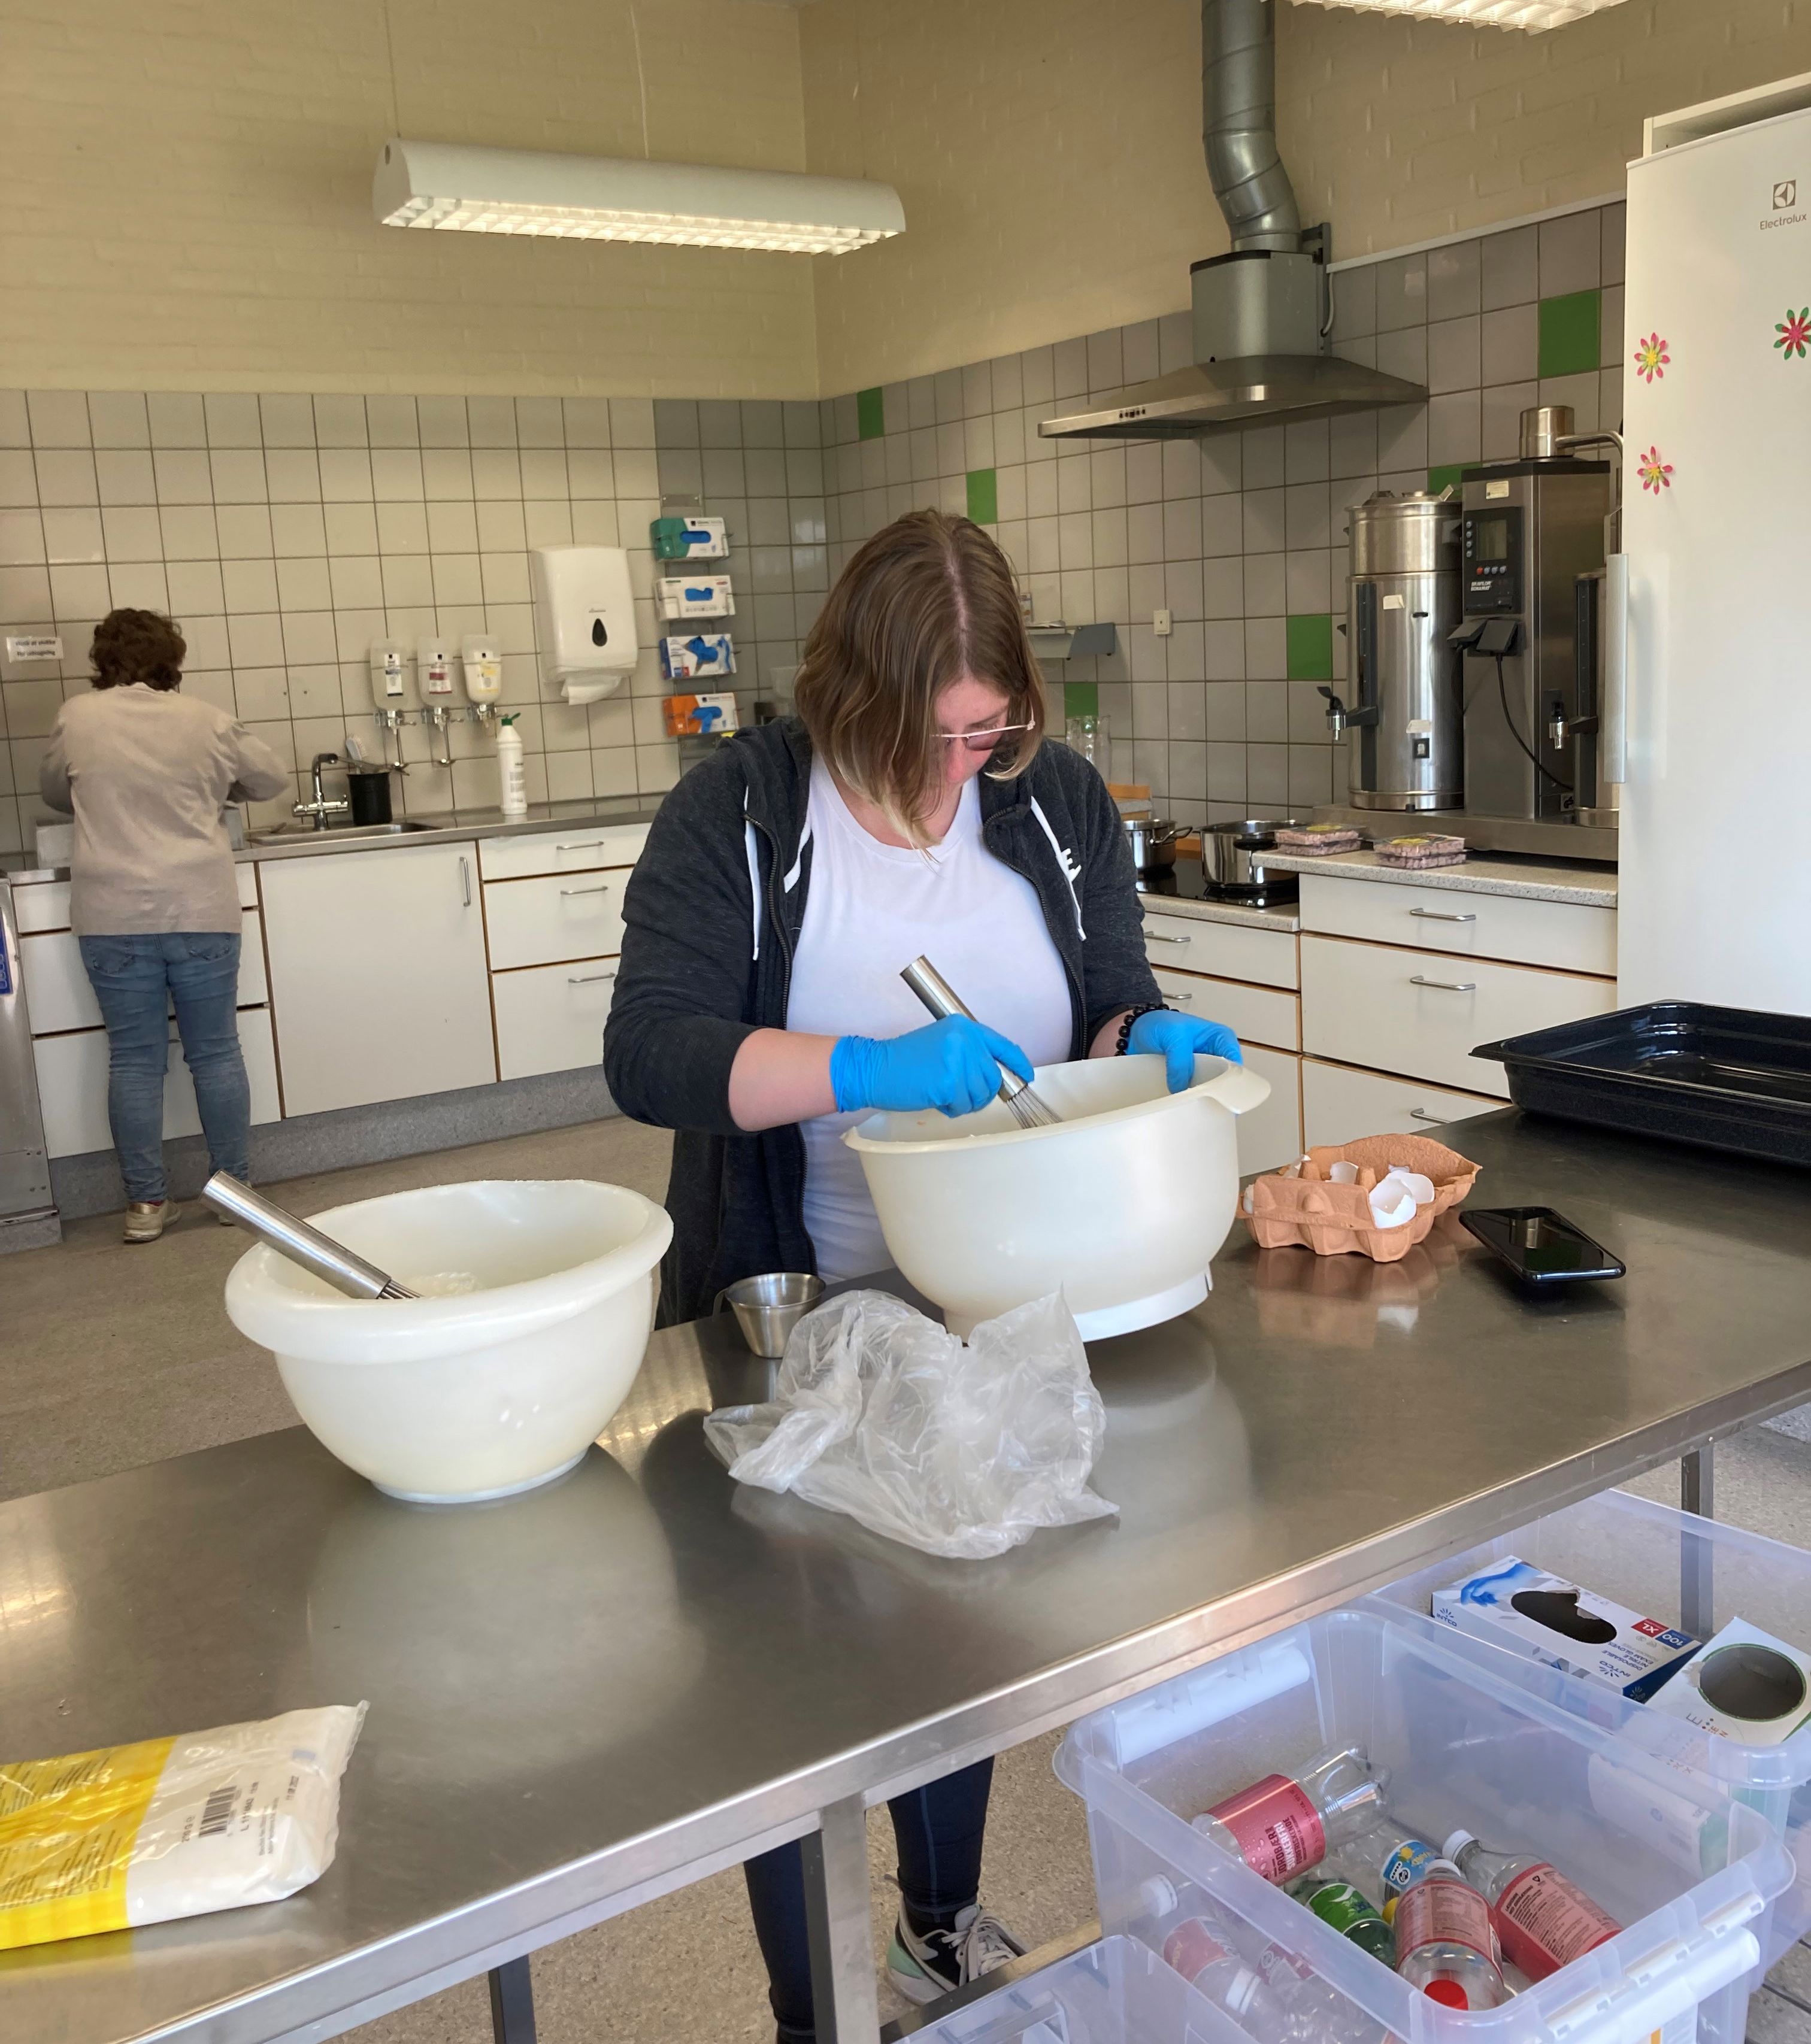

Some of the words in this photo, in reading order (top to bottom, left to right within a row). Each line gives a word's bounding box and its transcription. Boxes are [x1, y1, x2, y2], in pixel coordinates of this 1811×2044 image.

[1759, 213, 1807, 230] Electrolux
[1642, 1623, 1659, 1633] XL
[1662, 1634, 1683, 1646] 100
[1600, 1660, 1631, 1677] INTCO
[1601, 1650, 1642, 1670] DISPOSABLE
[1624, 1654, 1649, 1667] NITRILE
[1273, 1821, 1296, 1870] SUKKERFRI
